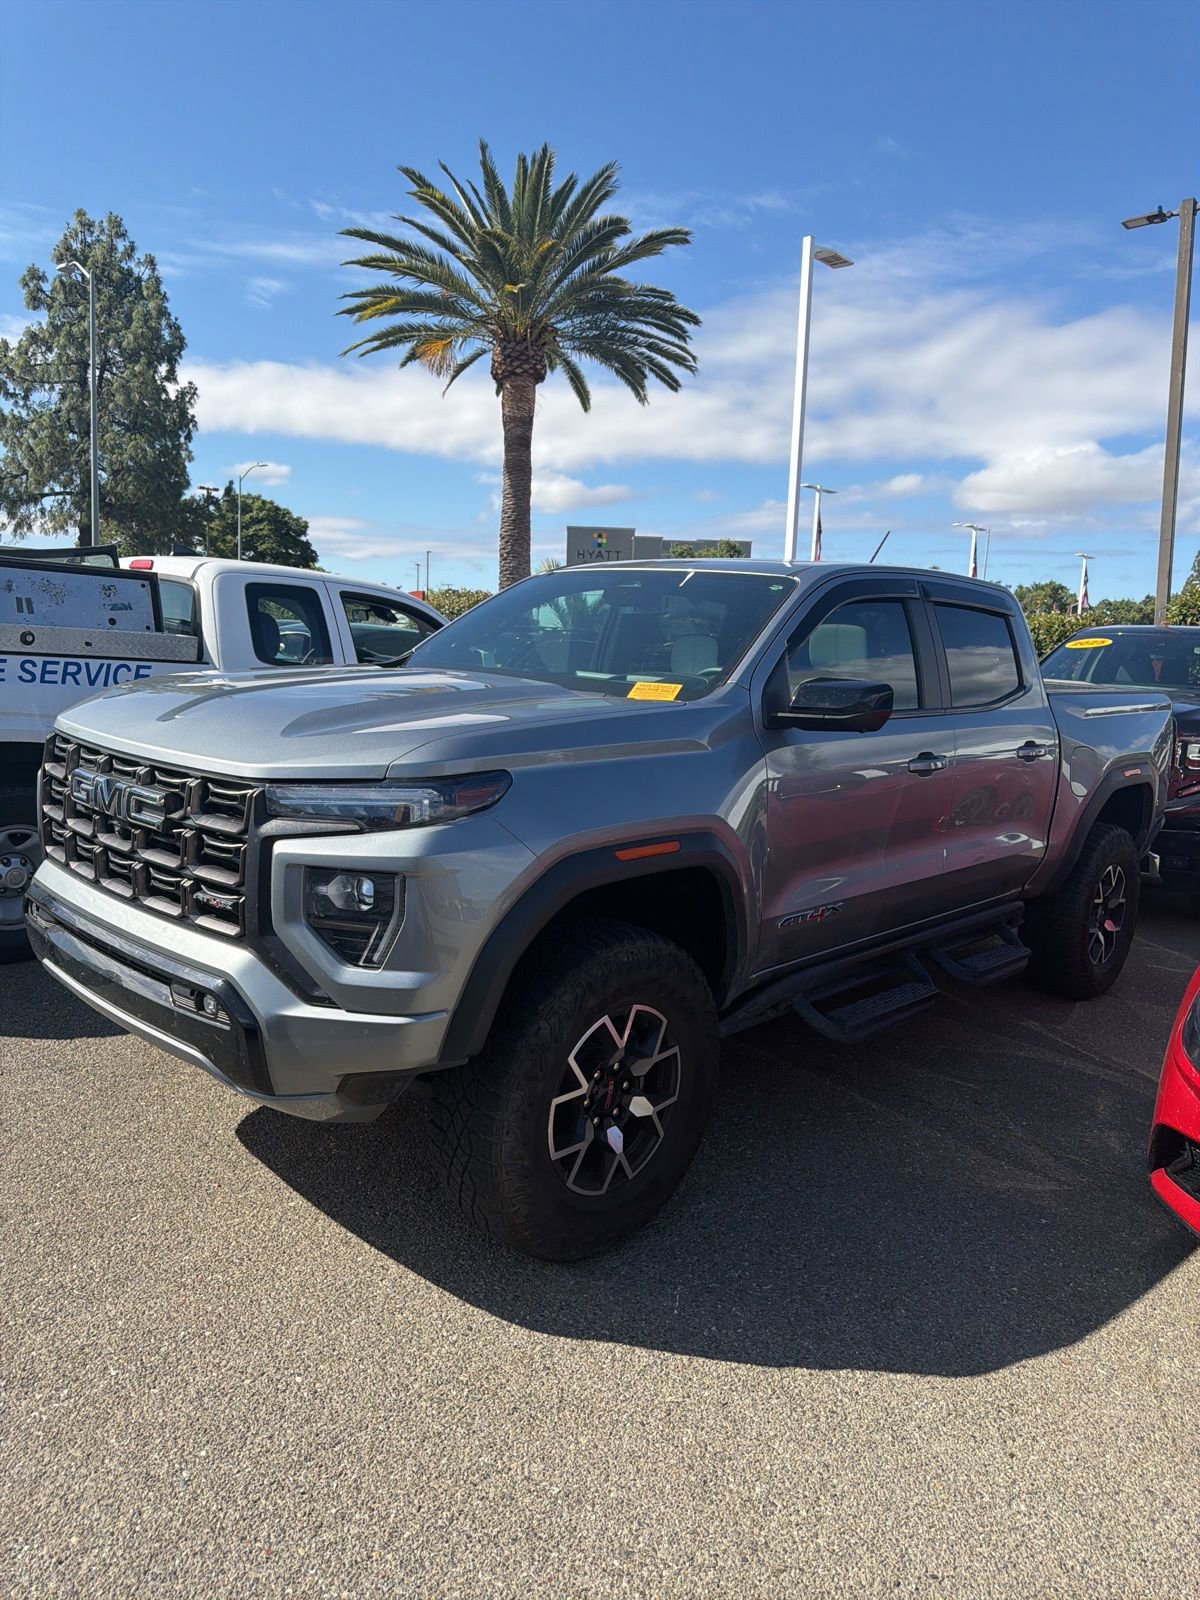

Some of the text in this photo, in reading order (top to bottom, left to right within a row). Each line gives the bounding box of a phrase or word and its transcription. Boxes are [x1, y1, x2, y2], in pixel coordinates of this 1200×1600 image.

[576, 549, 622, 560] HYATT
[1072, 639, 1105, 647] 2025
[17, 659, 153, 688] SERVICE
[70, 768, 166, 831] GMC
[777, 902, 844, 929] AT4X
